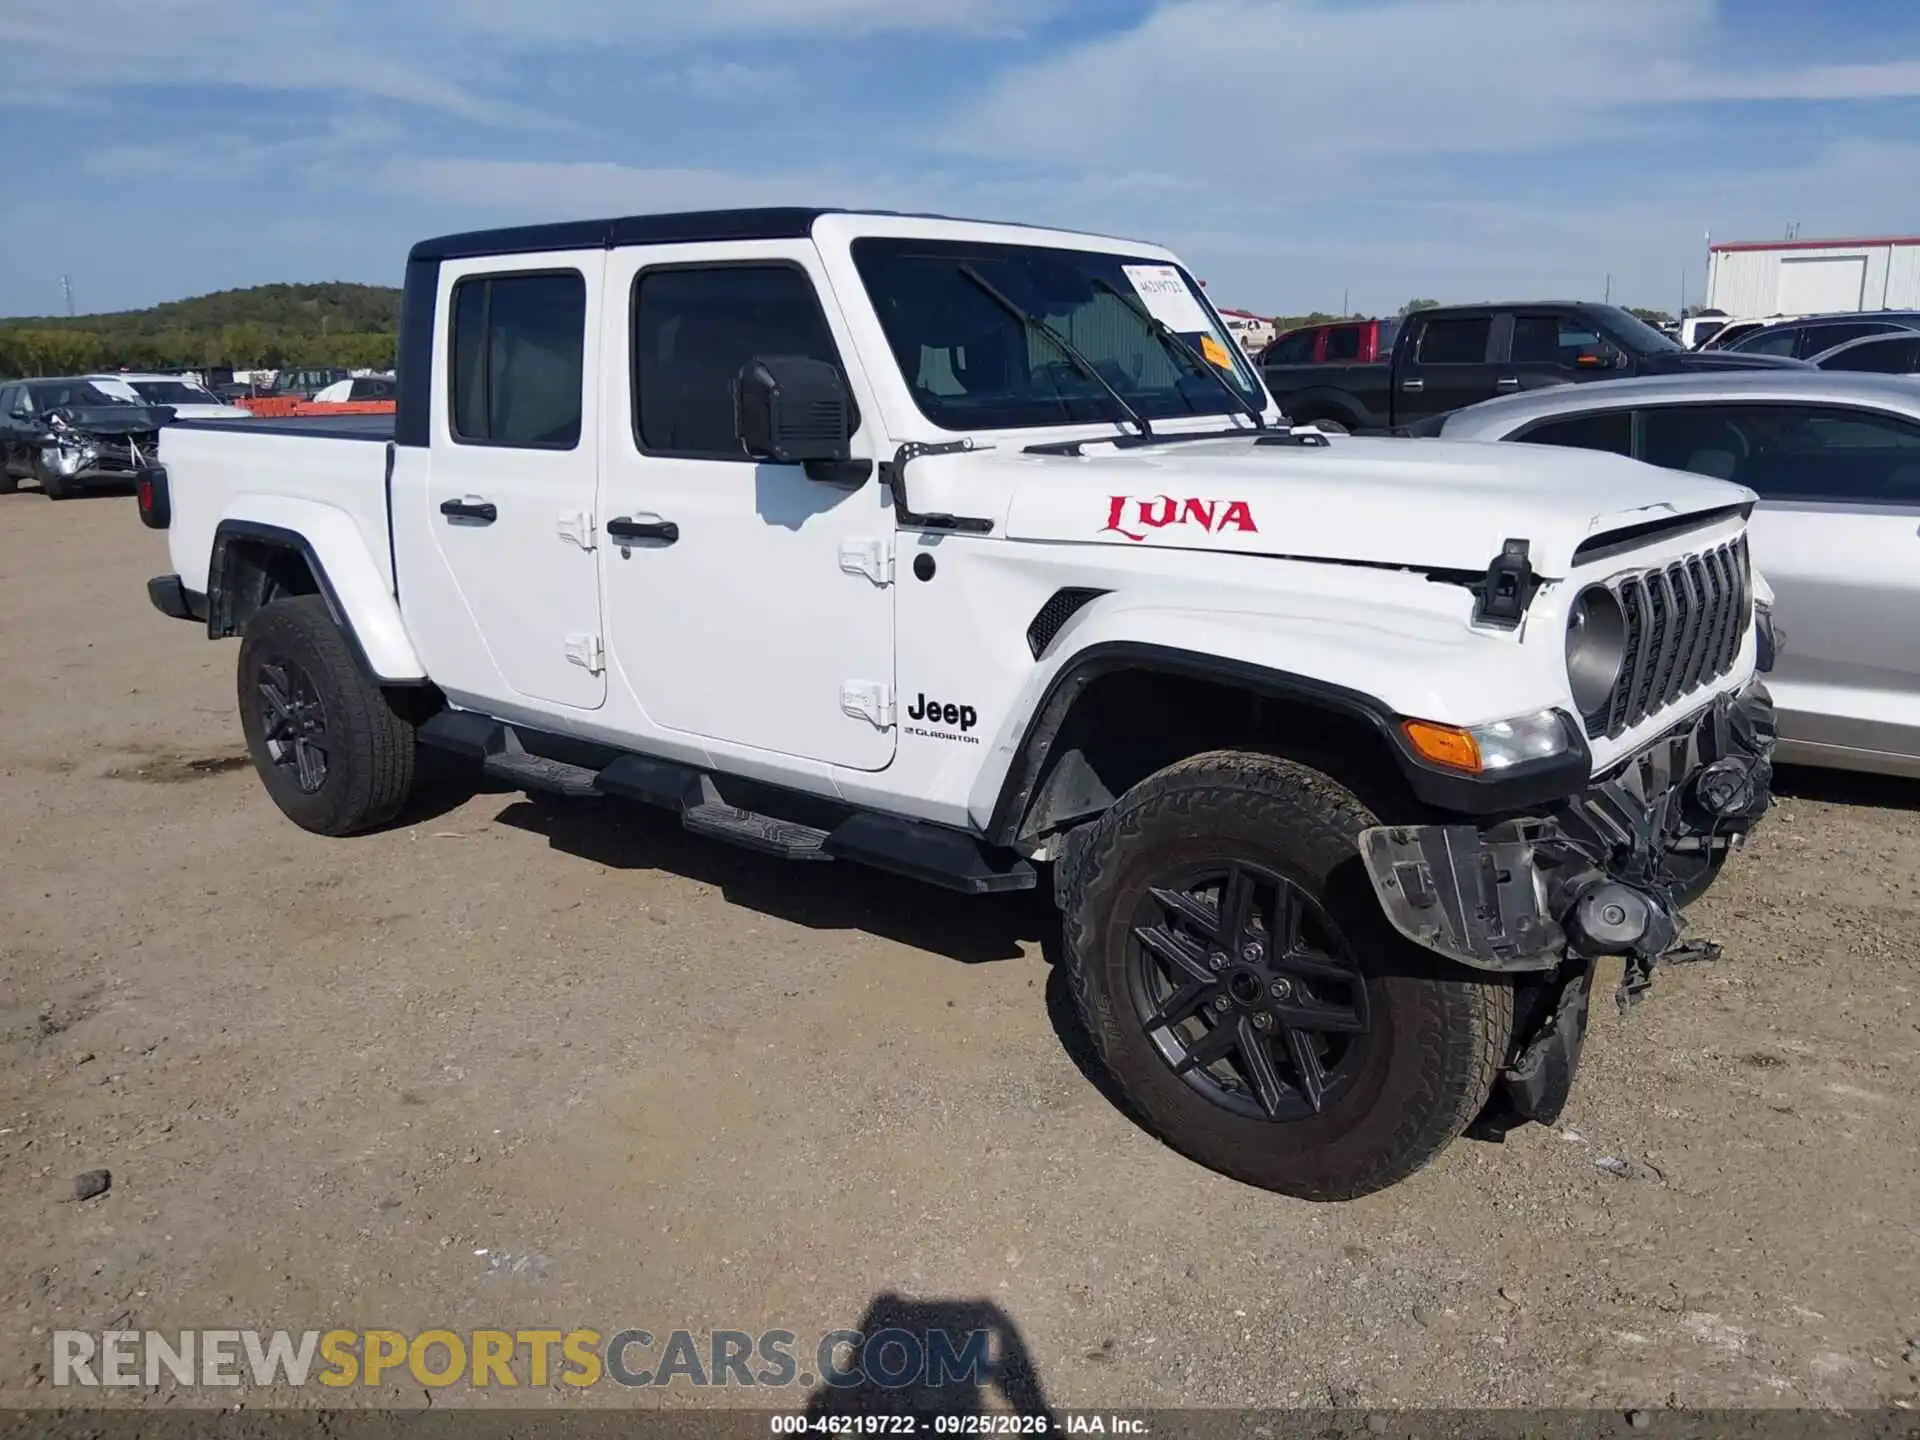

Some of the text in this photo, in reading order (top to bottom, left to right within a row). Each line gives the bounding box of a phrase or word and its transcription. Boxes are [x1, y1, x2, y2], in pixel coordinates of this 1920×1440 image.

[1097, 494, 1259, 541] LUNA
[907, 692, 977, 732] Jeep
[915, 728, 979, 744] GLADIATOR
